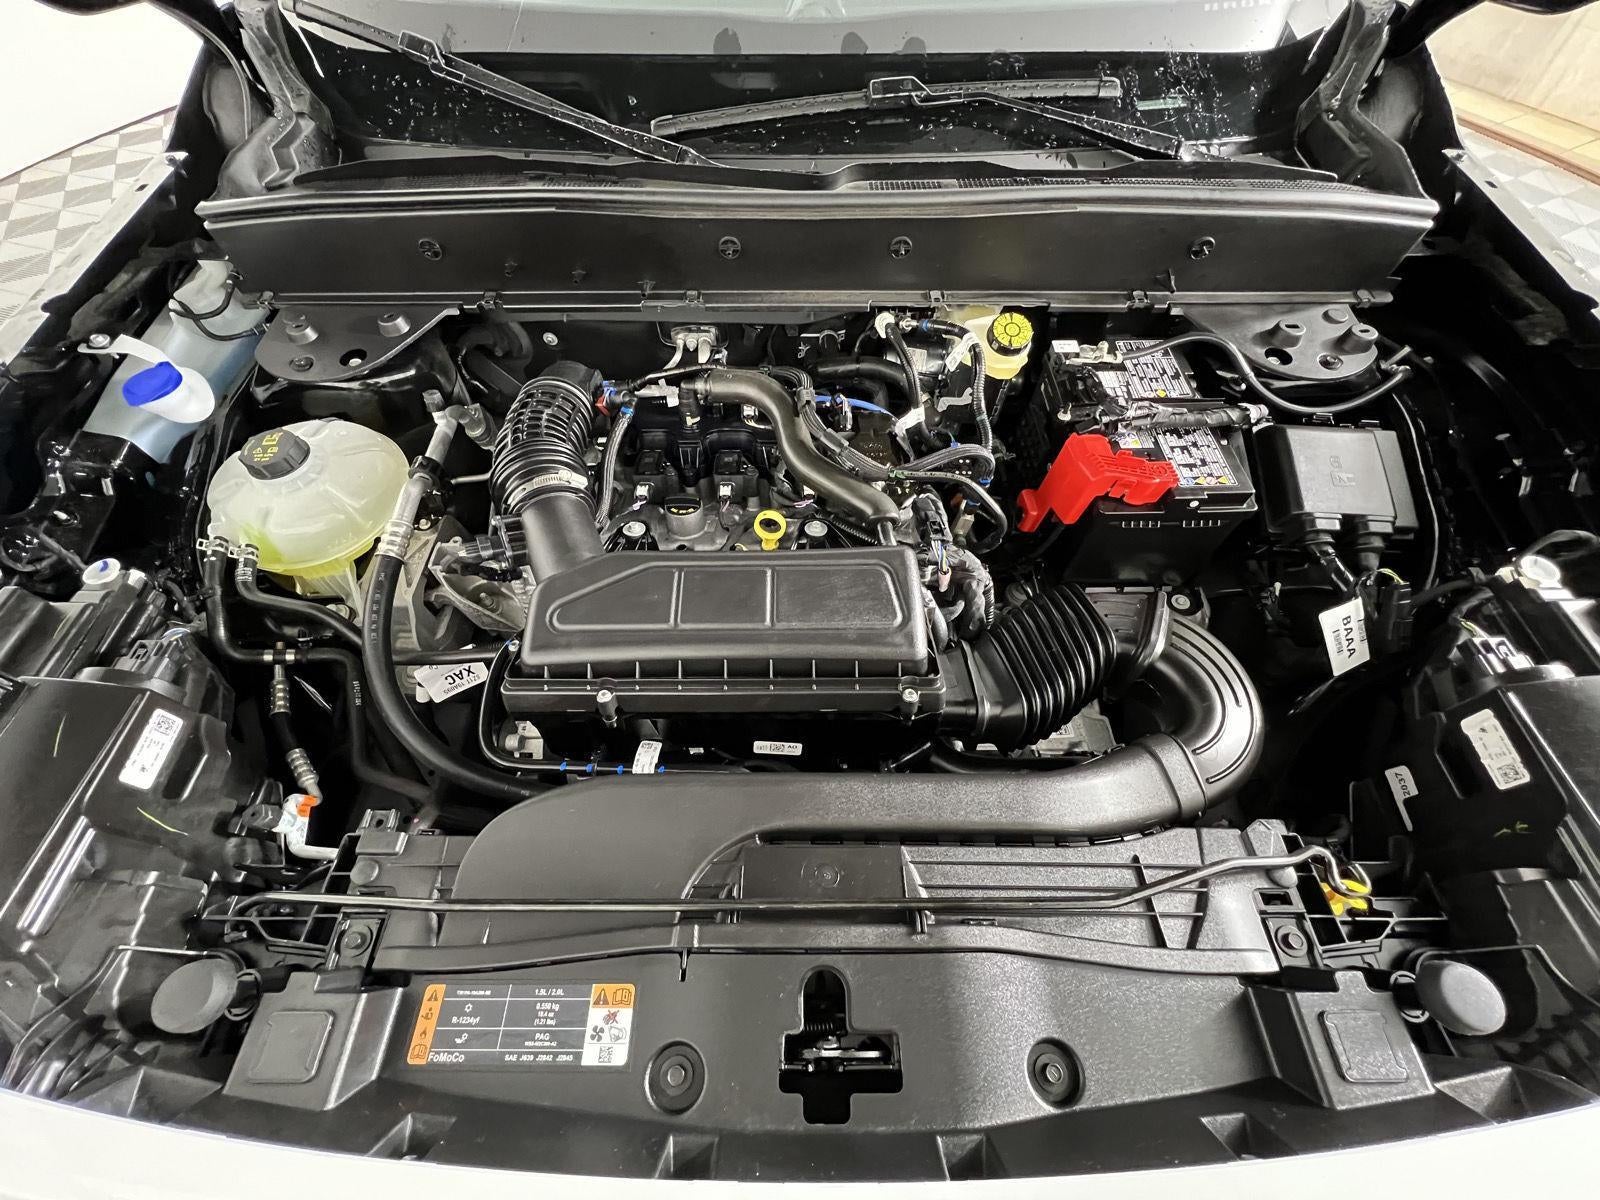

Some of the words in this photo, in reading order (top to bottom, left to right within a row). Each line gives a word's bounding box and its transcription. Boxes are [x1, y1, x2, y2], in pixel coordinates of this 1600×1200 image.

[1341, 615, 1356, 659] BAAA
[444, 665, 476, 686] XAC
[1394, 772, 1411, 797] 2037
[535, 988, 548, 996] 1.5L
[551, 1002, 560, 1012] kg
[451, 1016, 481, 1026] R-1234yf
[535, 1033, 550, 1041] PAG
[427, 1052, 465, 1062] FoMoCo
[504, 1054, 518, 1062] SAE
